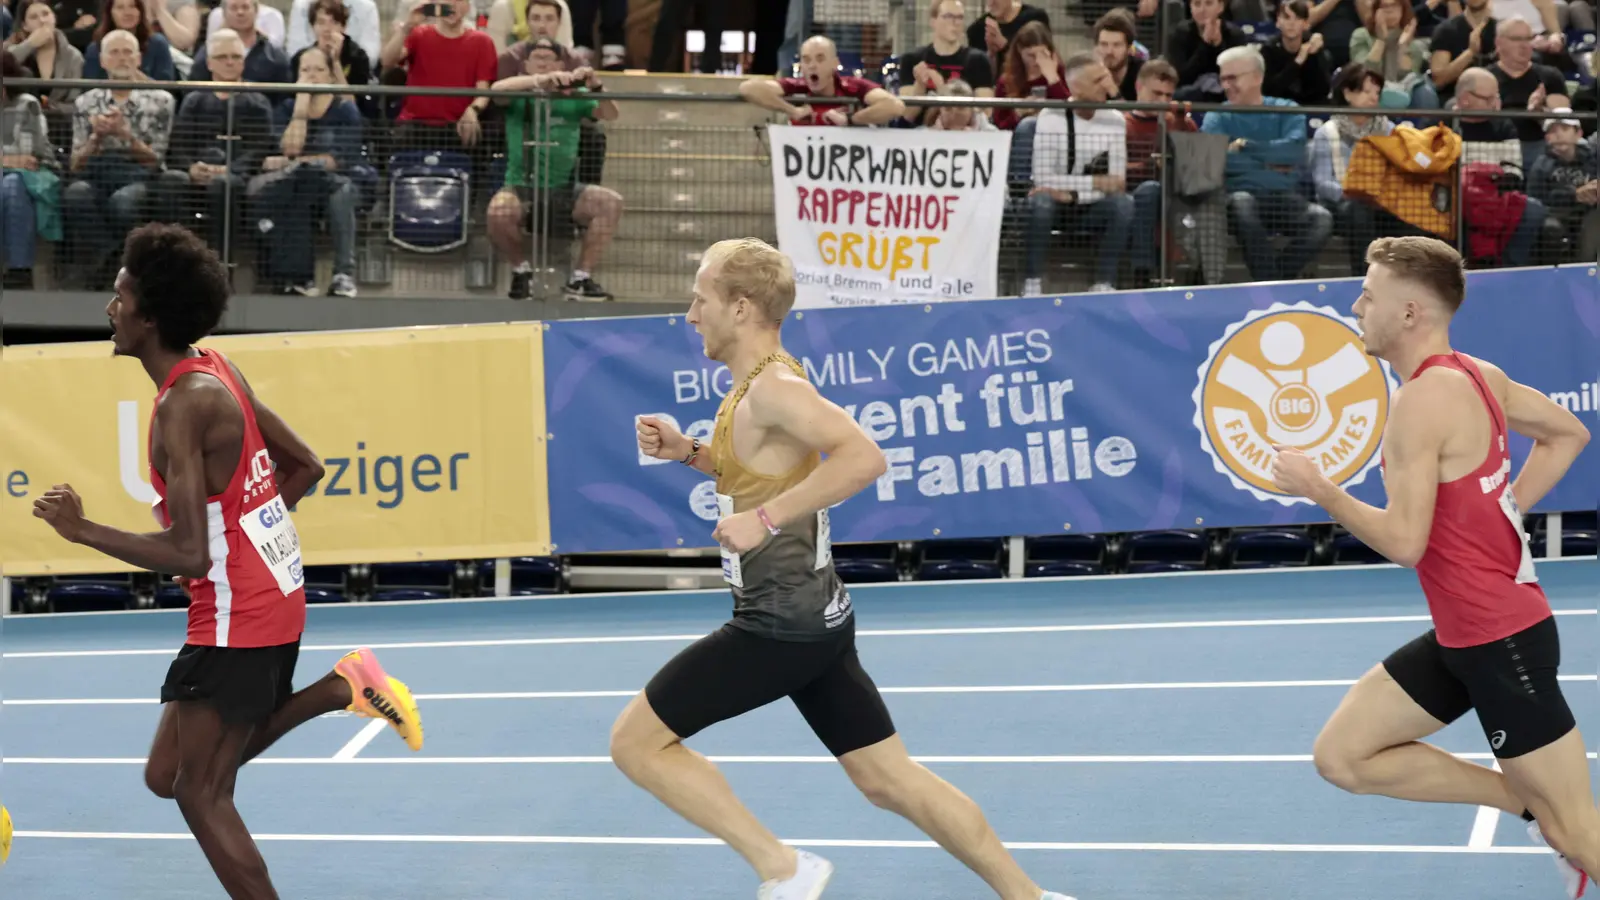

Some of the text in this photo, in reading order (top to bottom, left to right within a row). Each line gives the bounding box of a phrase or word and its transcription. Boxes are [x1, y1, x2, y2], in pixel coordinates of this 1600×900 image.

[783, 136, 994, 188] DÜRRWANGEN
[797, 186, 960, 231] RAPPENHOF
[834, 273, 883, 292] Bremm
[900, 275, 933, 289] und
[673, 328, 1053, 404] BIG MILY GAMES
[979, 370, 1074, 428] für
[1277, 397, 1312, 416] BIG
[876, 426, 1138, 502] Familie
[1224, 413, 1368, 472] FAMI AMES
